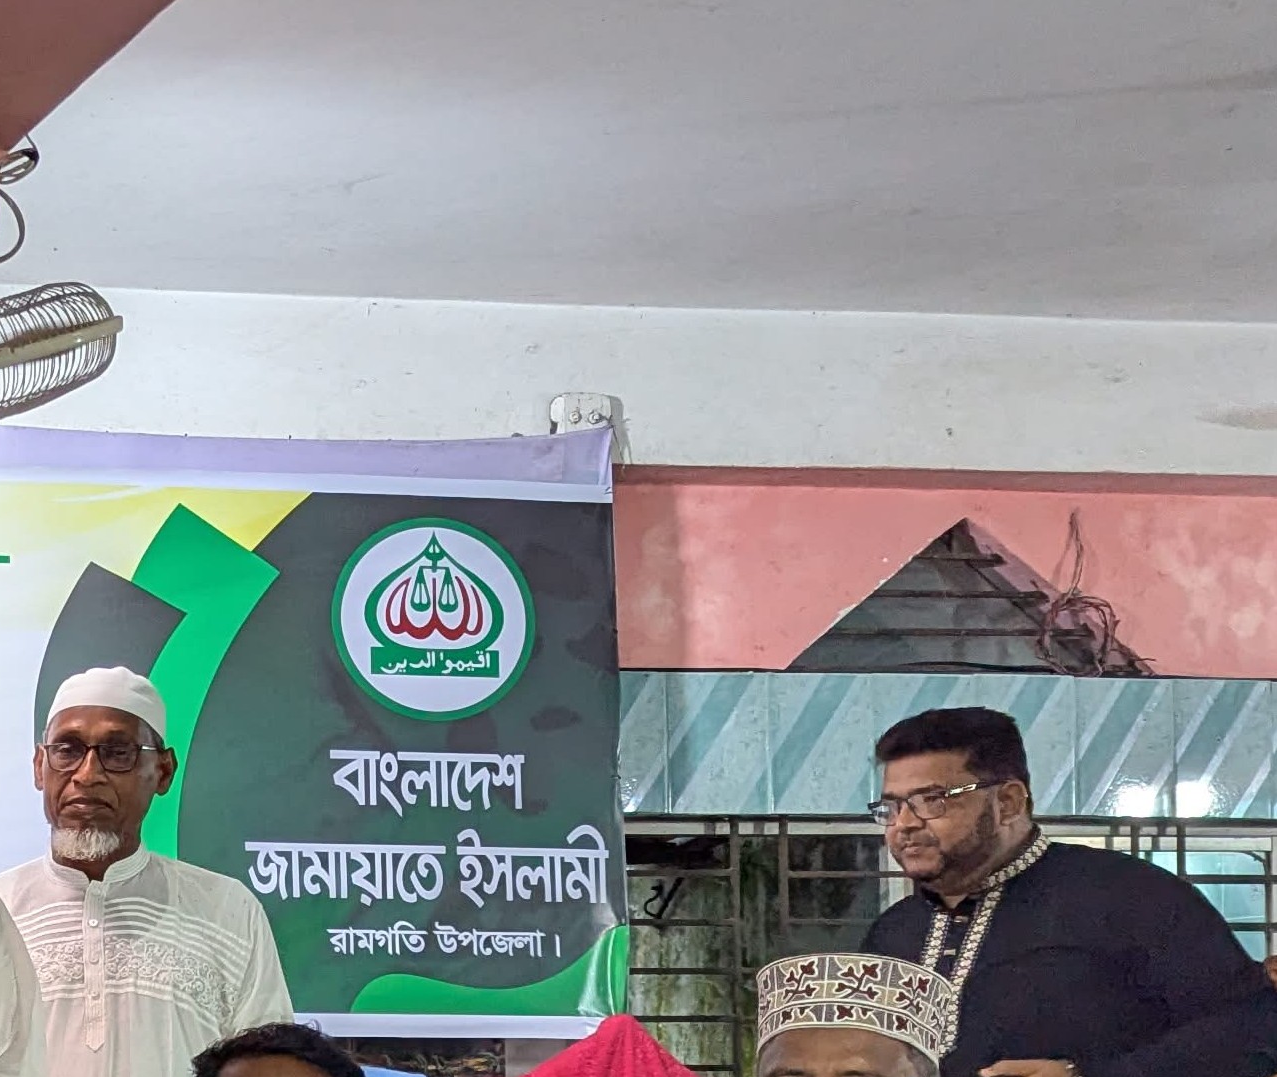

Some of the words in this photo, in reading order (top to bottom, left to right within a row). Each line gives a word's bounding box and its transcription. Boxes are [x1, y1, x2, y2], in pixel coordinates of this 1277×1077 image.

[330, 750, 525, 817] বাংলাদেশ
[245, 841, 446, 906] জামায়াতে
[457, 825, 609, 908] ইসলামী
[327, 920, 428, 955] রামগতি
[432, 921, 546, 958] উপজেলা
